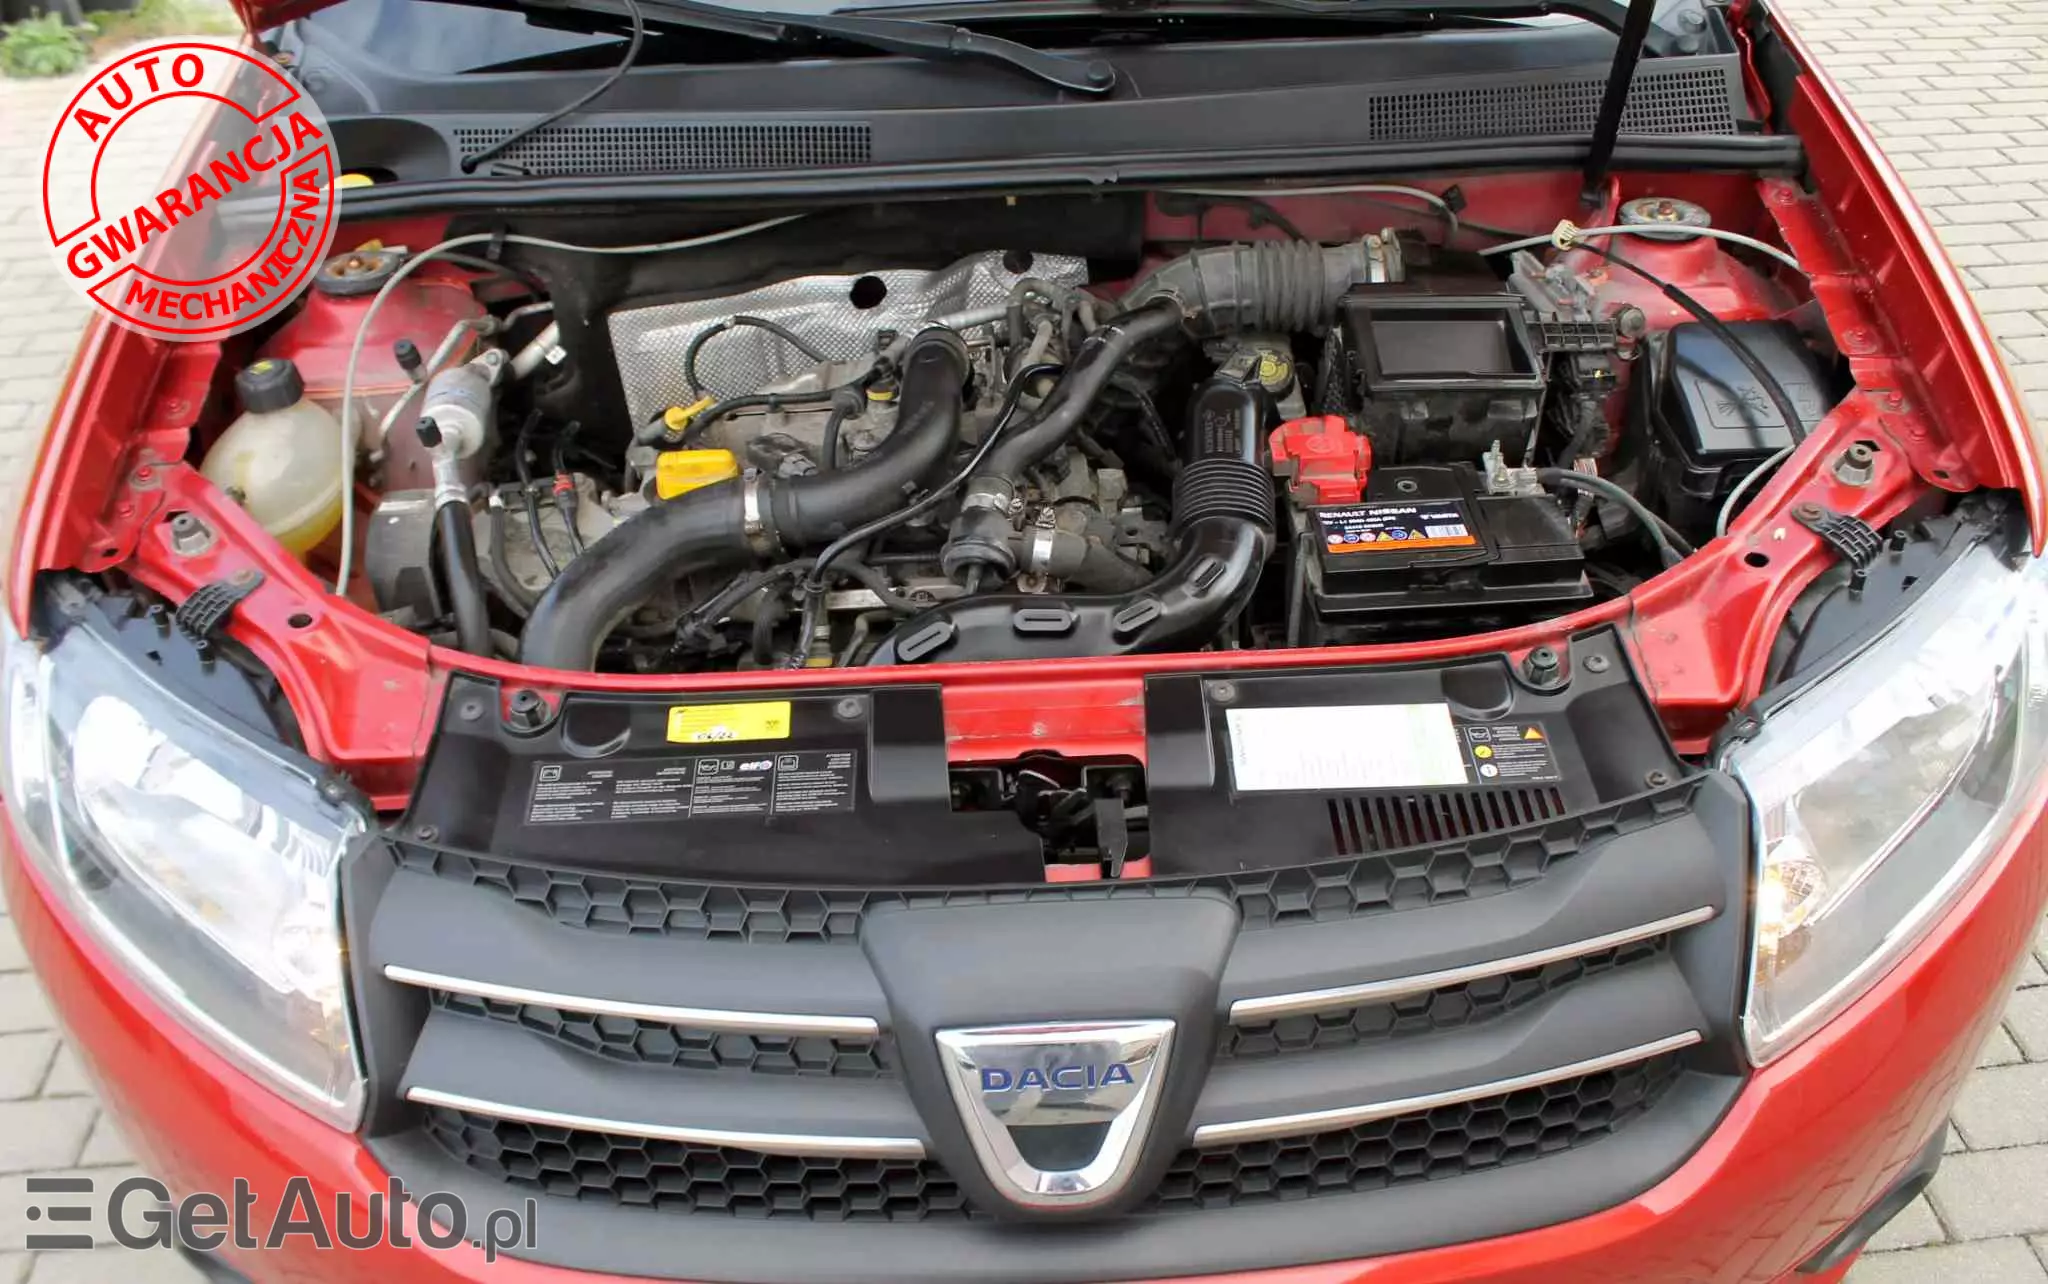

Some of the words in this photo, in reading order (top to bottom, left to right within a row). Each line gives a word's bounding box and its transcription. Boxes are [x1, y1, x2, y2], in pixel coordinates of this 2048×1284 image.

[1319, 510, 1366, 518] RENAULT
[1368, 507, 1417, 516] NISSAN
[981, 1063, 1134, 1092] DACIA
